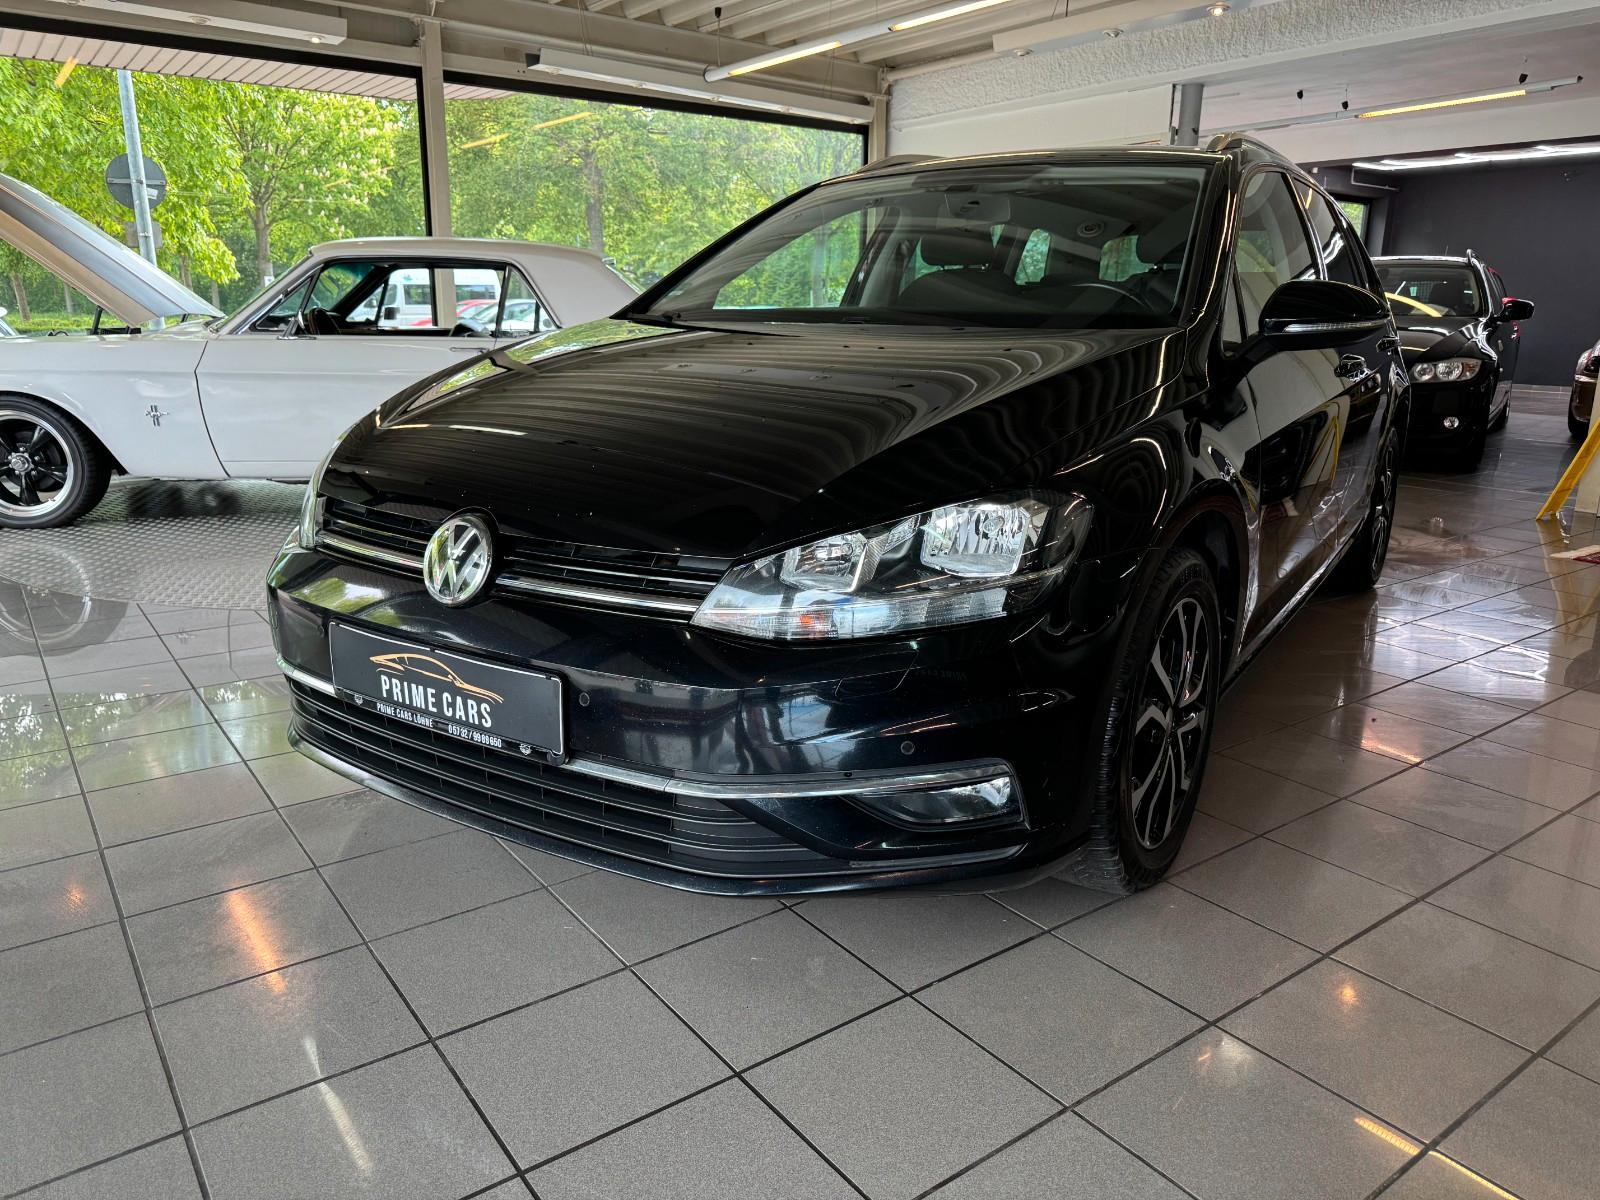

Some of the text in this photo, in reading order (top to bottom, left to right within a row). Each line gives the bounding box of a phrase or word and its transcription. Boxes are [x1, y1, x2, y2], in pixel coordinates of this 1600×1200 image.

[427, 515, 489, 604] VW
[376, 702, 395, 716] PRIME
[396, 708, 413, 721] CARS
[380, 674, 492, 728] PRIME CARS
